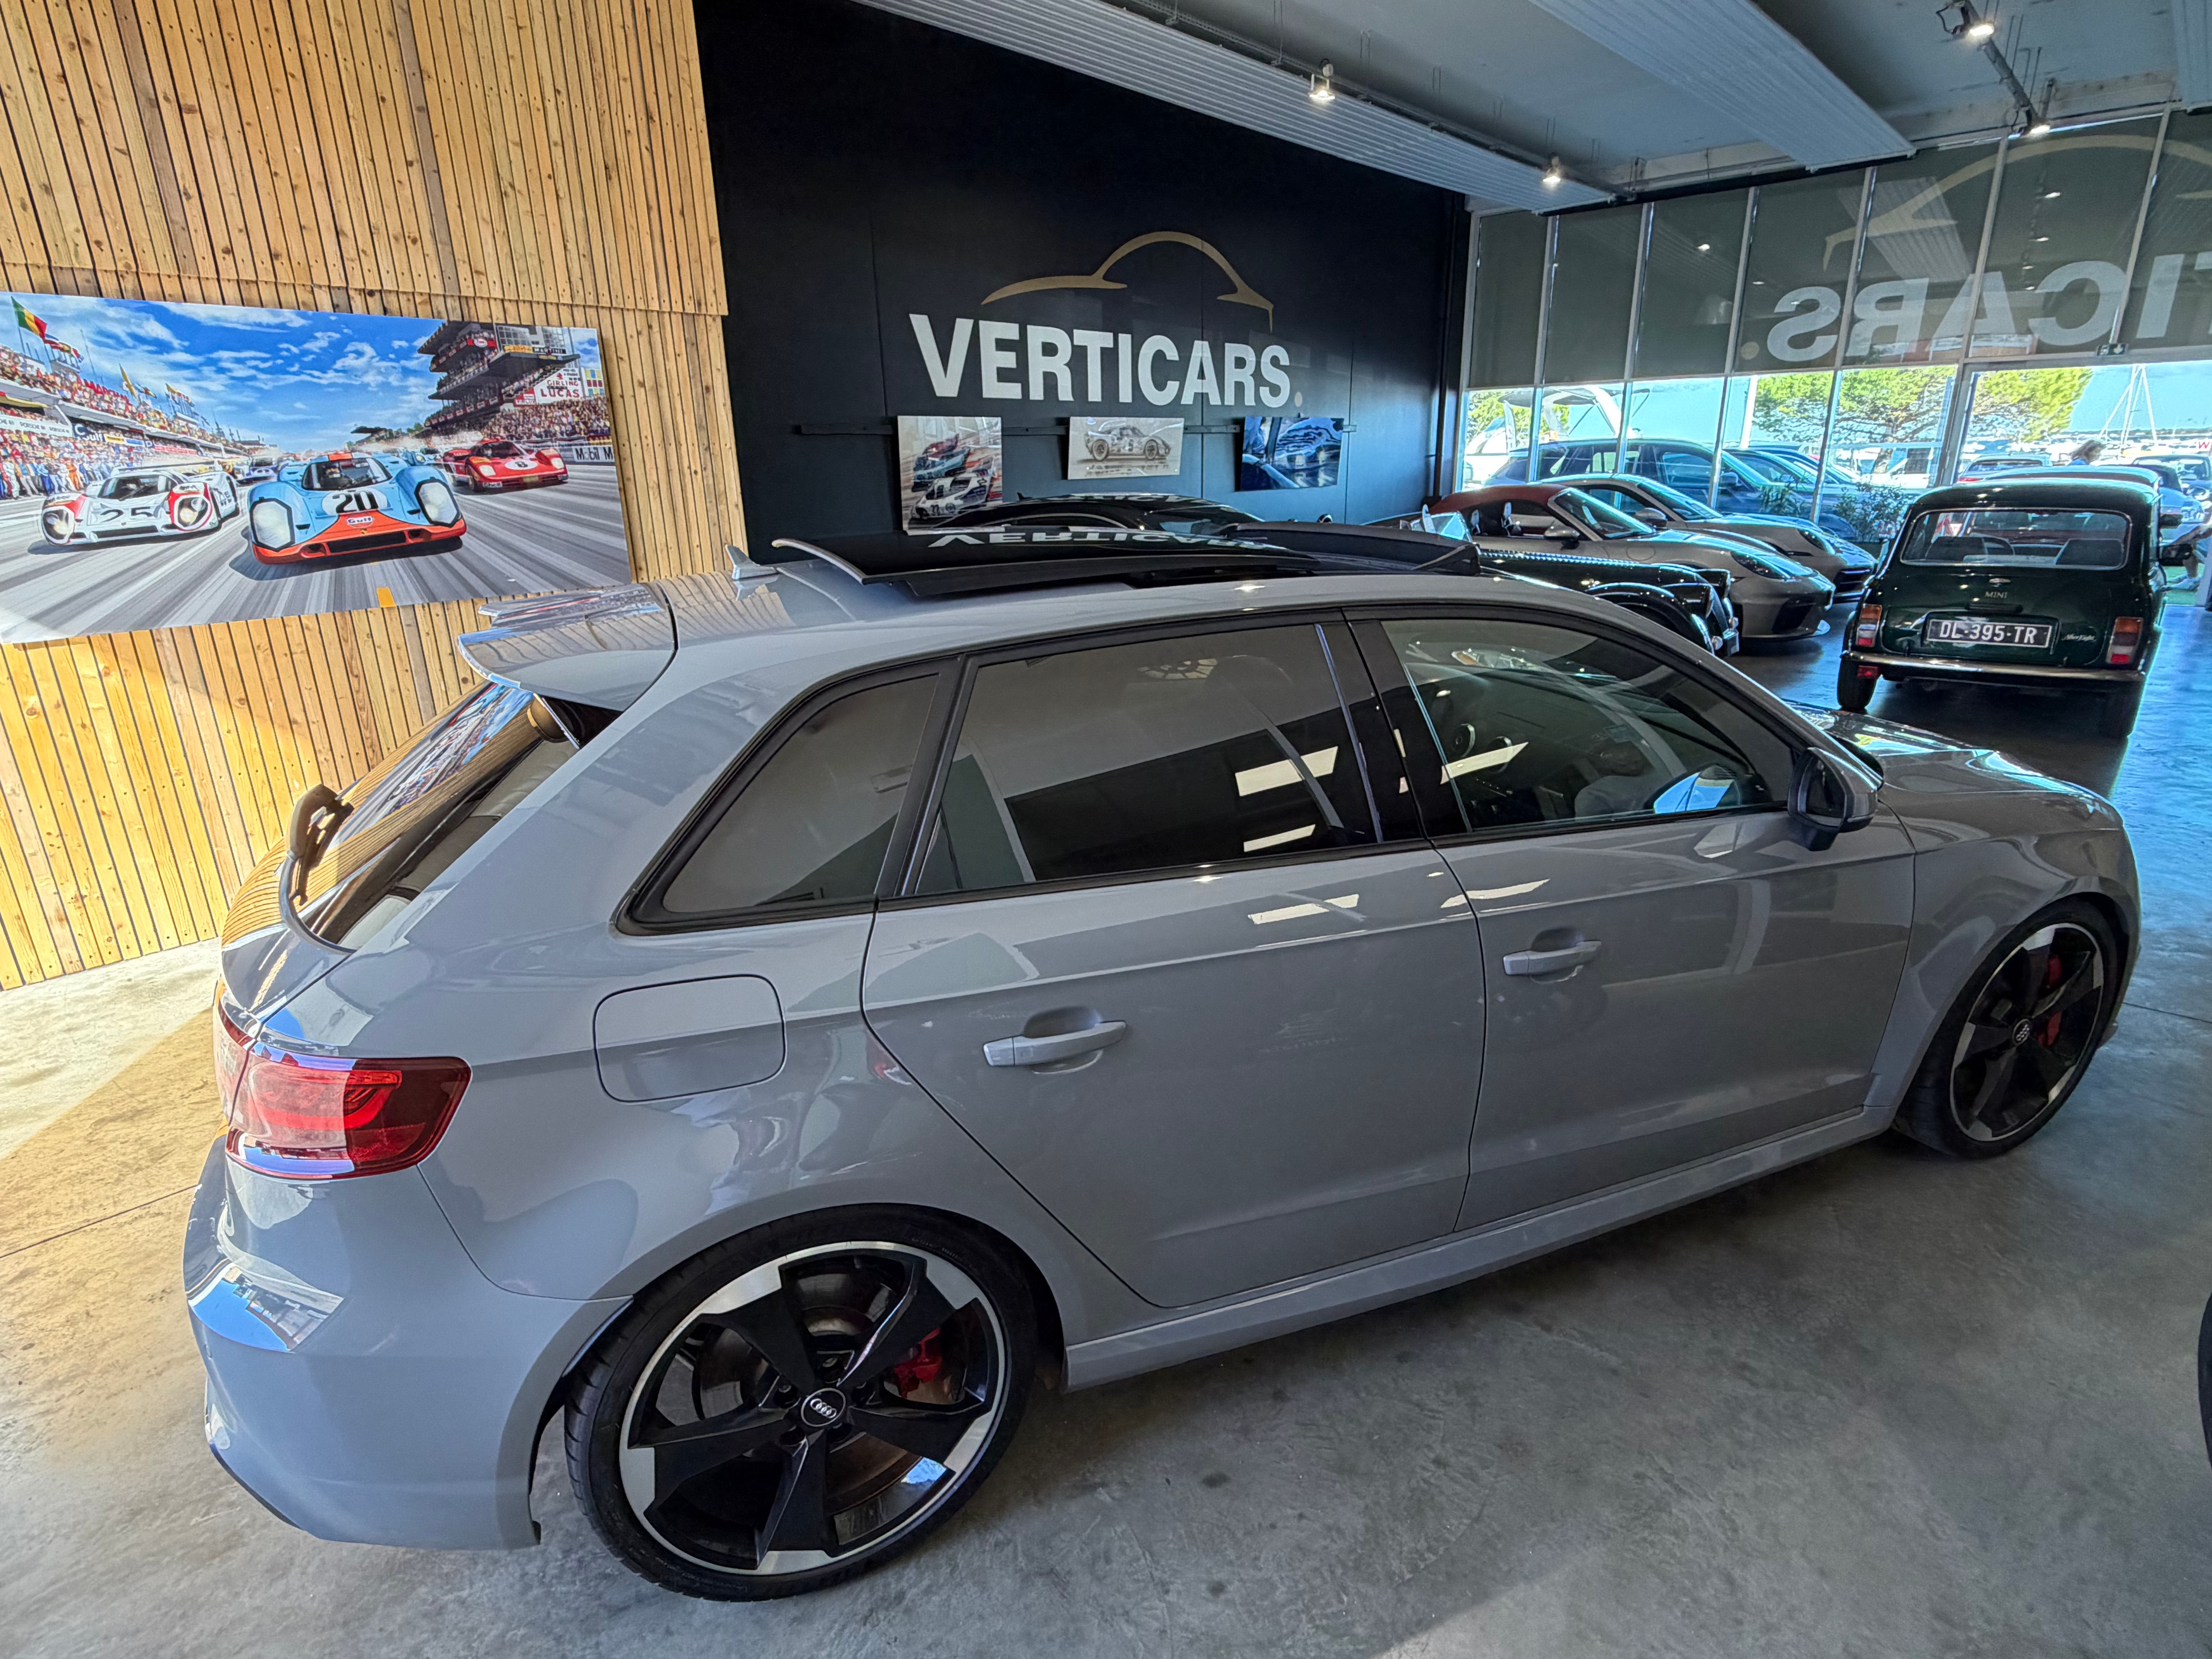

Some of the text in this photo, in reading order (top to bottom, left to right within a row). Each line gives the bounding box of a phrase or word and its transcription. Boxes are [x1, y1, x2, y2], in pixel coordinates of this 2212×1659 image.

[540, 388, 580, 398] LUCAS
[575, 446, 600, 460] Mobil
[332, 490, 379, 514] 20
[100, 506, 153, 522] 25
[1939, 622, 2037, 644] DL-395-TR
